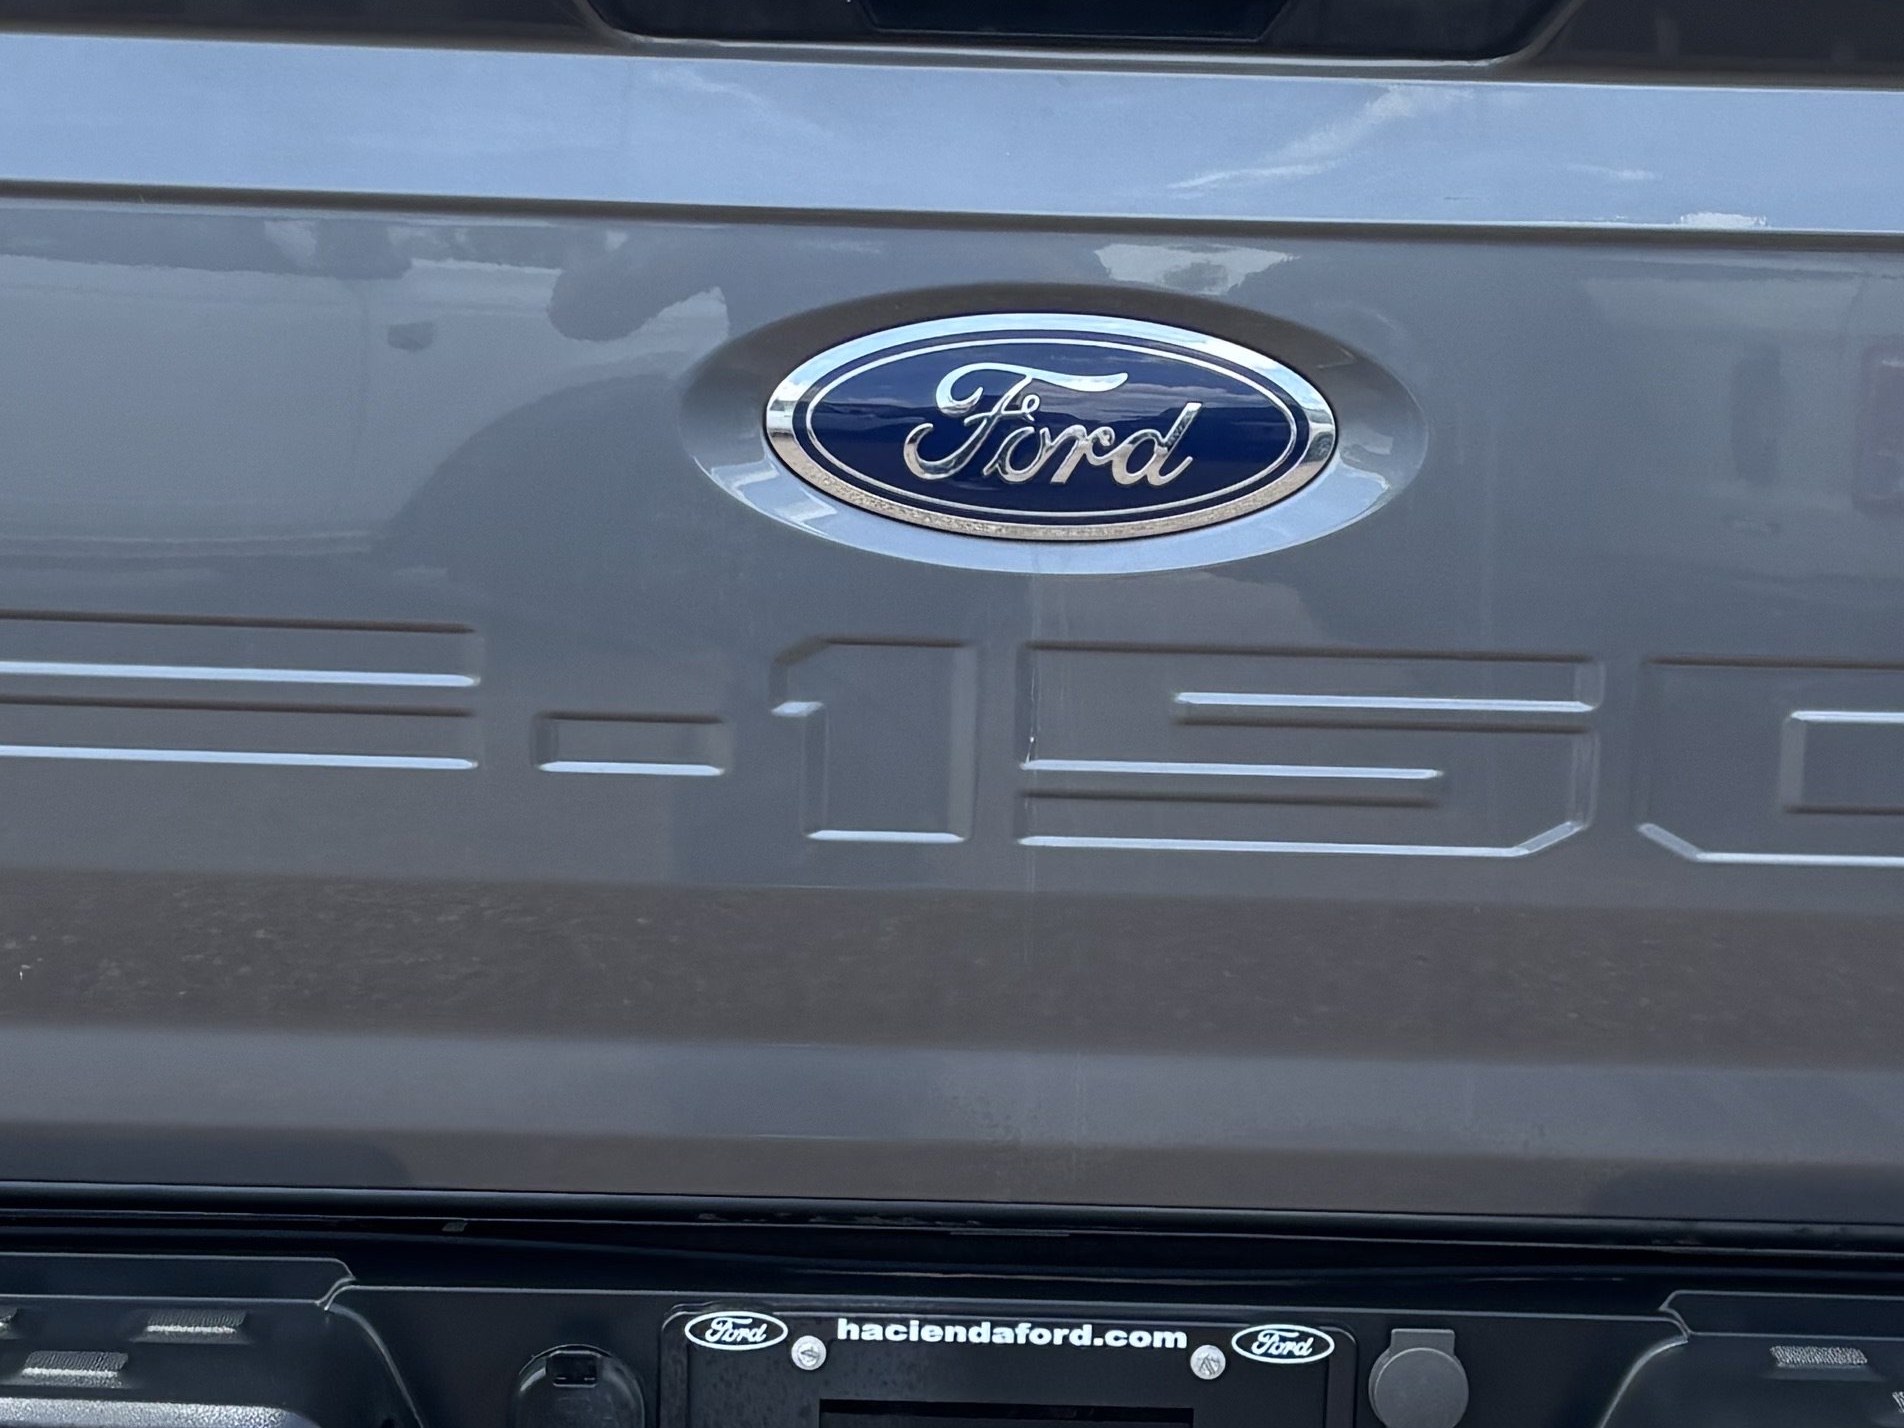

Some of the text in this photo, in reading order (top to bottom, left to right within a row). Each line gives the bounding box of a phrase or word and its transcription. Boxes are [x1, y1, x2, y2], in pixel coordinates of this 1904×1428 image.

[903, 361, 1203, 487] Ford
[703, 1317, 770, 1344] Ford
[836, 1318, 1188, 1350] haciendaford.com
[1250, 1330, 1314, 1357] Ford
